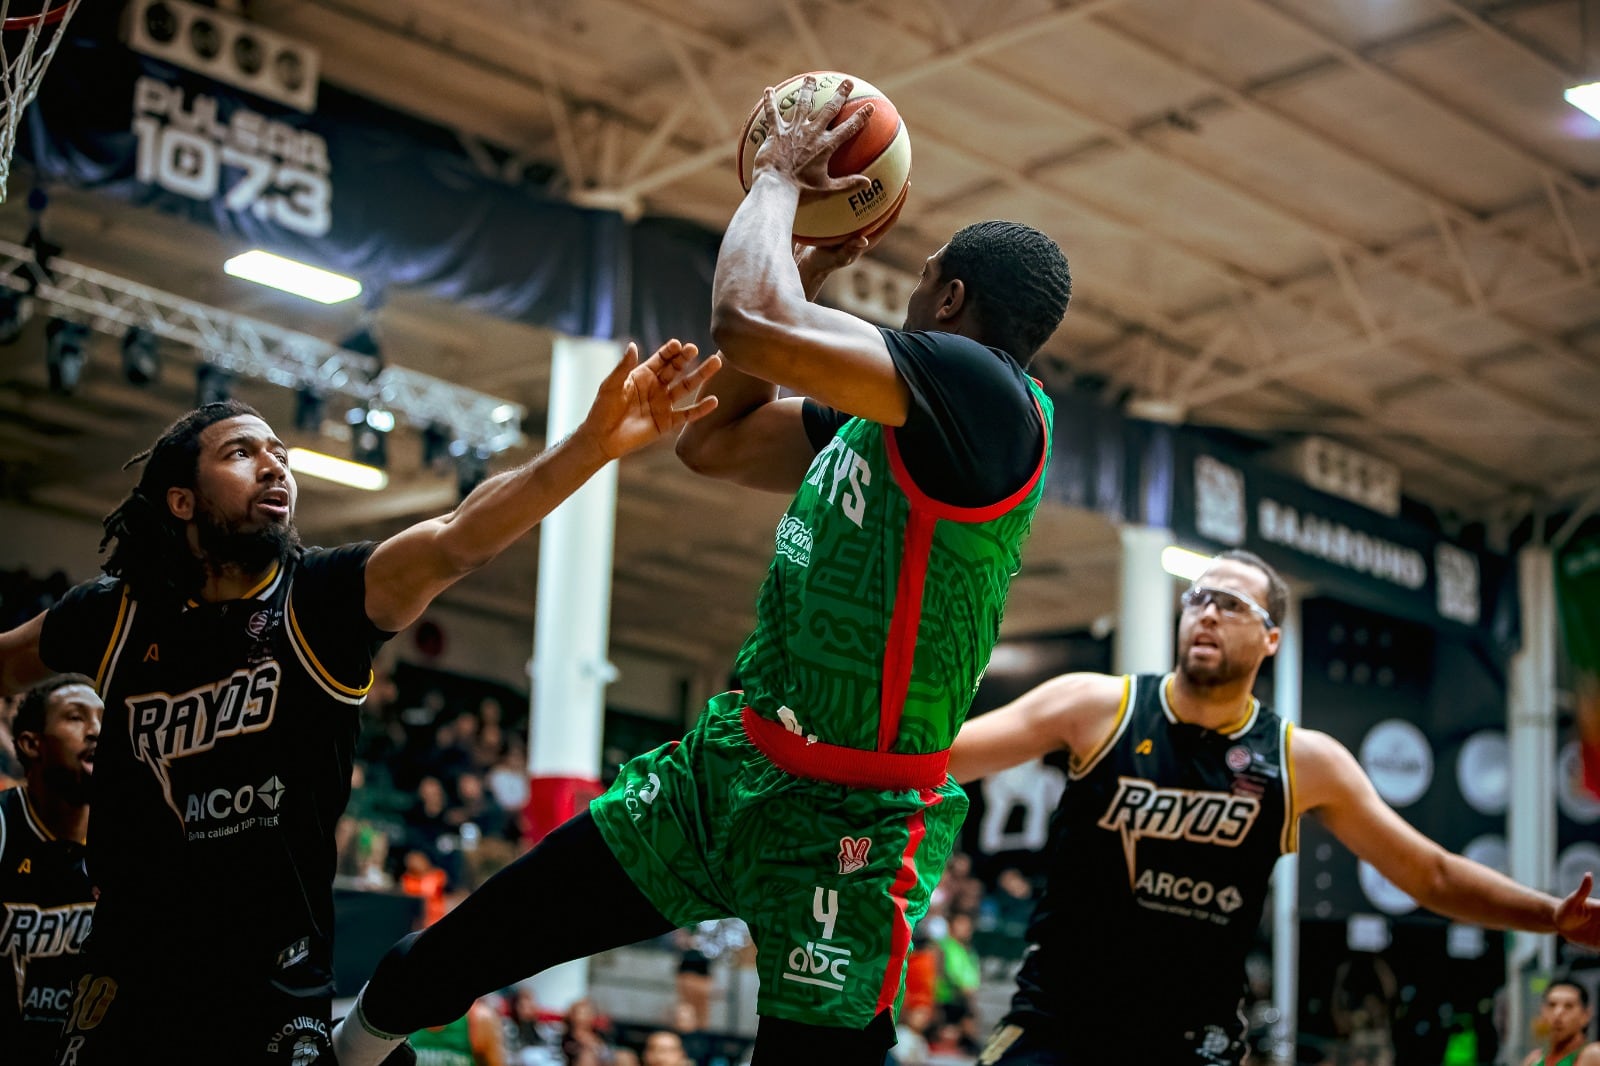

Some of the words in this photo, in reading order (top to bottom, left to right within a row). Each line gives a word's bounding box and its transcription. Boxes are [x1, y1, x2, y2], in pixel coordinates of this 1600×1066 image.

[133, 75, 331, 172] PULSAR
[134, 118, 333, 237] 107.3
[848, 178, 884, 212] FIBA
[125, 660, 282, 768] RAYOS
[208, 824, 240, 840] calidad
[257, 815, 280, 827] TIER
[1098, 776, 1262, 848] RAYOS
[812, 886, 839, 940] 4
[1136, 869, 1215, 905] ARCO
[0, 902, 96, 957] RAYO
[787, 941, 851, 983] abc
[24, 986, 72, 1011] ARC
[66, 973, 119, 1035] 10
[267, 1015, 332, 1053] BUQUIBIC
